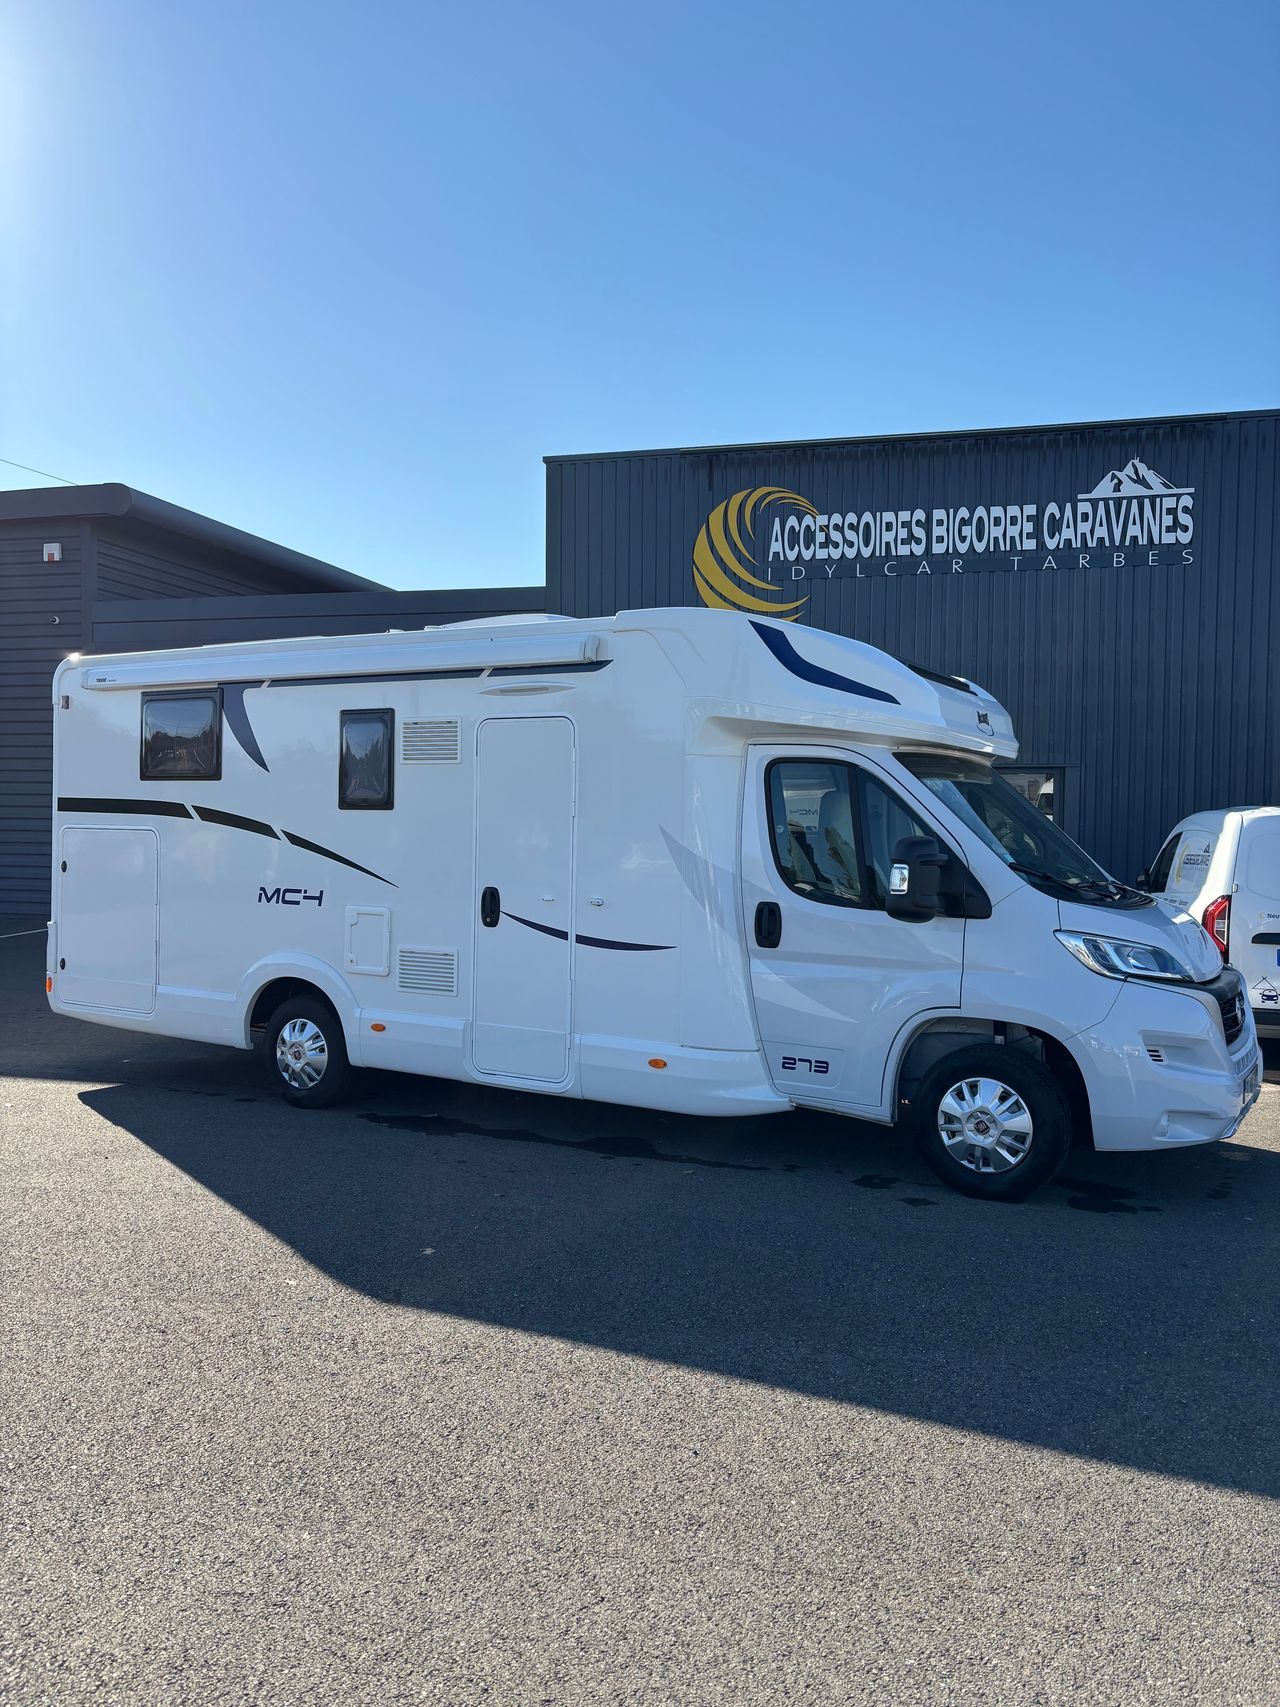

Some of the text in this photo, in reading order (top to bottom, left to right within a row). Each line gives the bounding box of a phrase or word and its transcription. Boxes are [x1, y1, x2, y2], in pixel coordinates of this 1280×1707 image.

[768, 494, 1194, 562] ACCESSOIRES BIGORRE CARAVANES
[767, 549, 1194, 581] IDYLCAR TARBES
[781, 1056, 829, 1075] 273
